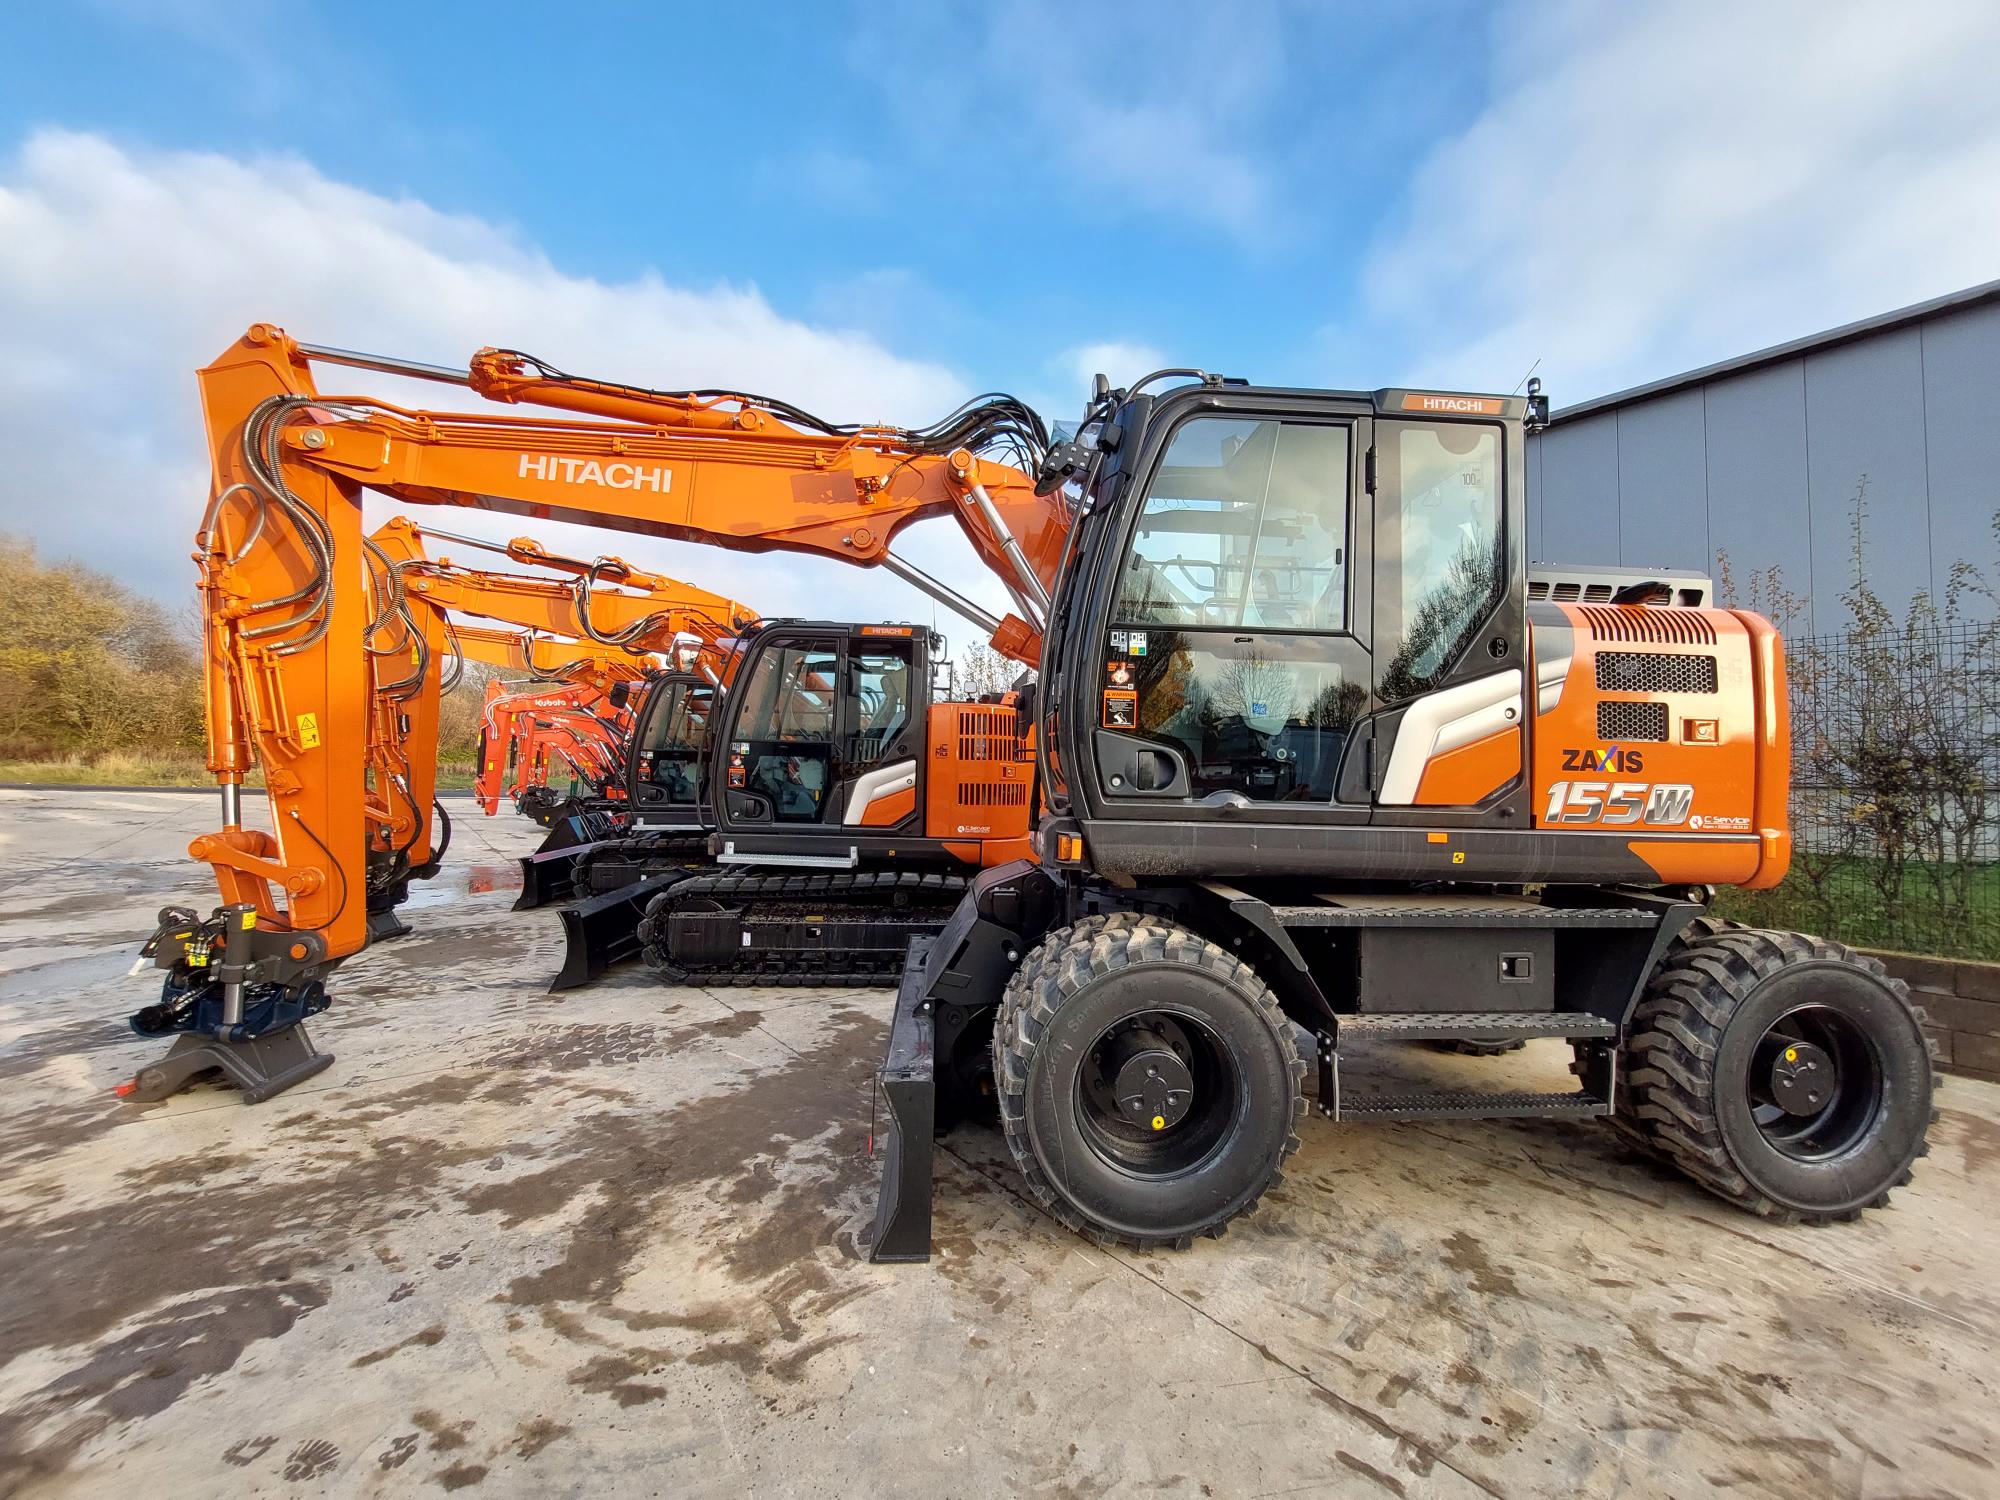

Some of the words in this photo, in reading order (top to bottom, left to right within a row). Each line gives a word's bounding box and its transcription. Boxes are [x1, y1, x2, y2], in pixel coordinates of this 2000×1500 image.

[1423, 398, 1483, 411] HITACHI
[518, 454, 672, 493] HITACHI
[872, 627, 903, 635] HITACHI
[535, 699, 567, 707] Kubota
[1562, 746, 1643, 773] ZAXIS
[1545, 781, 1695, 824] 155W
[1713, 815, 1751, 824] Service
